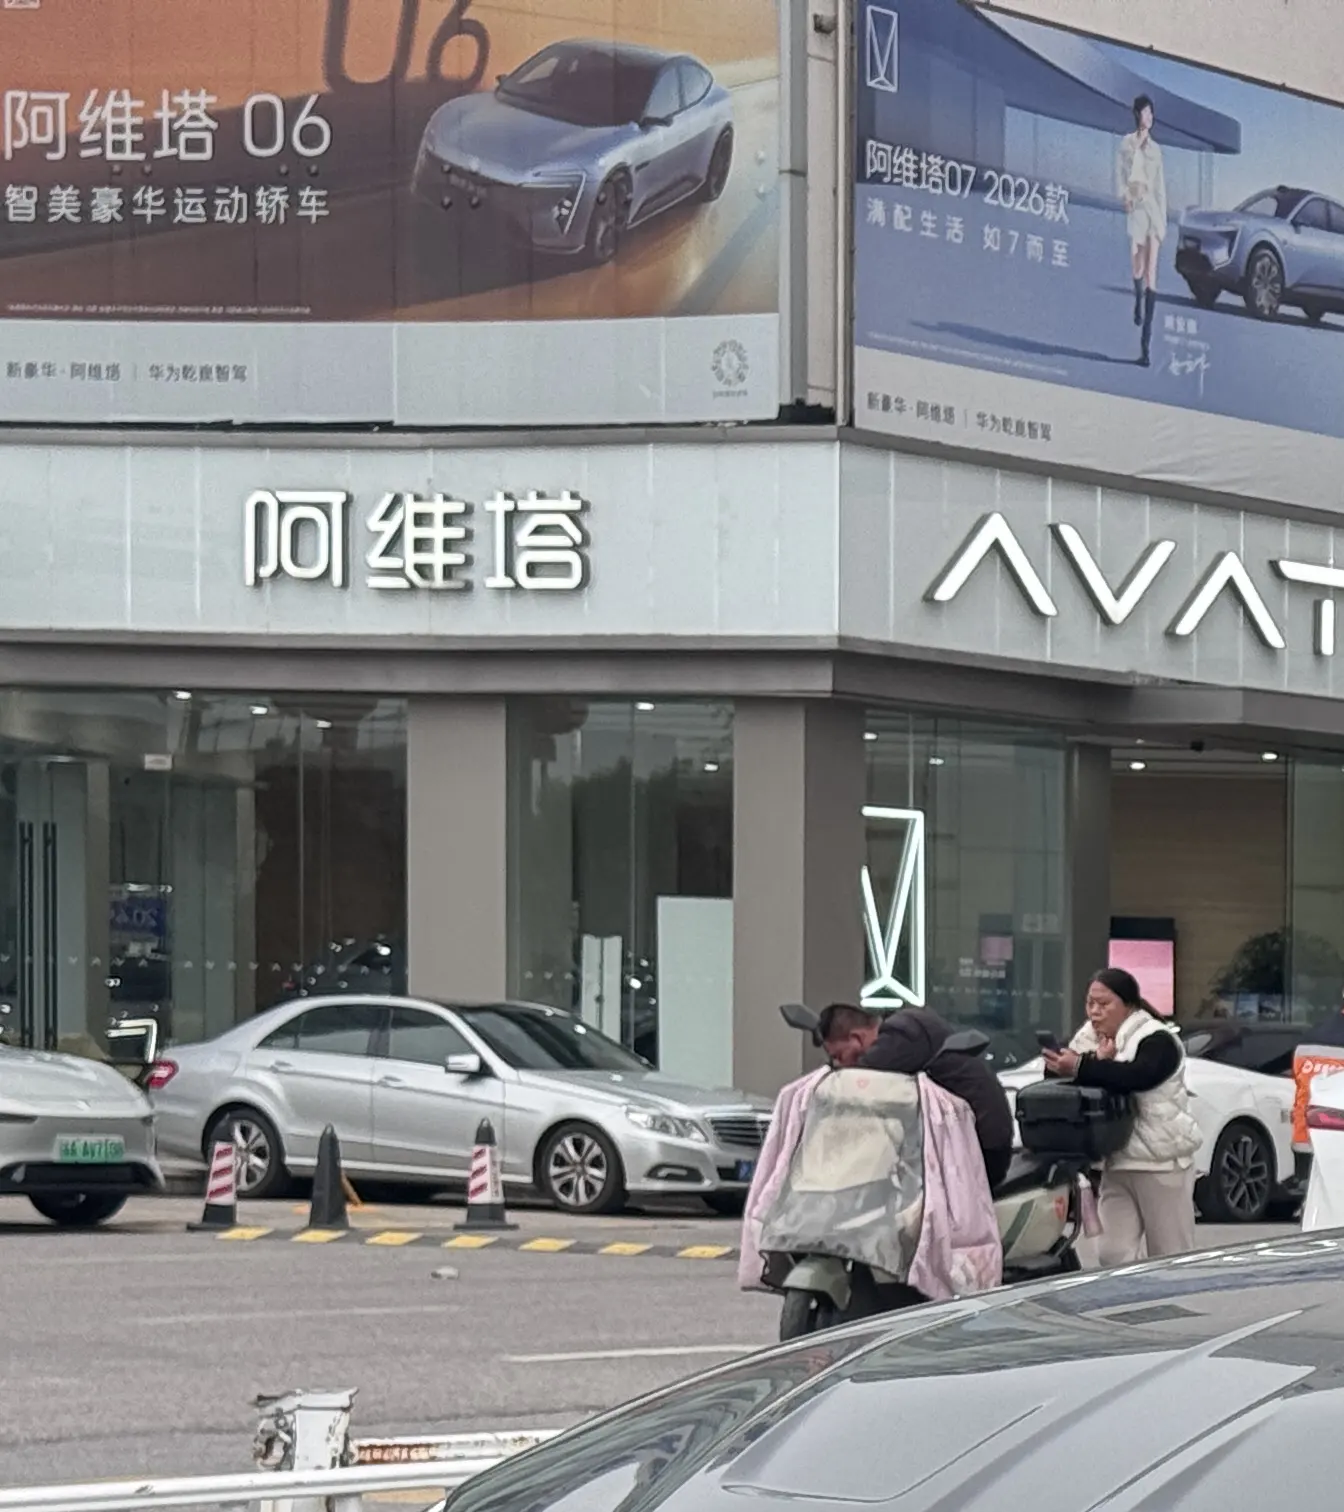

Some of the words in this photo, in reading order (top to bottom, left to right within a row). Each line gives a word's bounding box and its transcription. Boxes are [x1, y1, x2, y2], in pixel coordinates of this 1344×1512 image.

[4, 88, 218, 161] 阿维塔
[243, 93, 332, 158] 06
[4, 184, 331, 225] 智美豪华运动轿车
[866, 139, 977, 198] 阿维塔07
[983, 169, 1070, 224] 2026款
[866, 197, 965, 244] 满配生活
[983, 223, 1071, 267] 如7而至
[244, 490, 586, 590] 阿维塔
